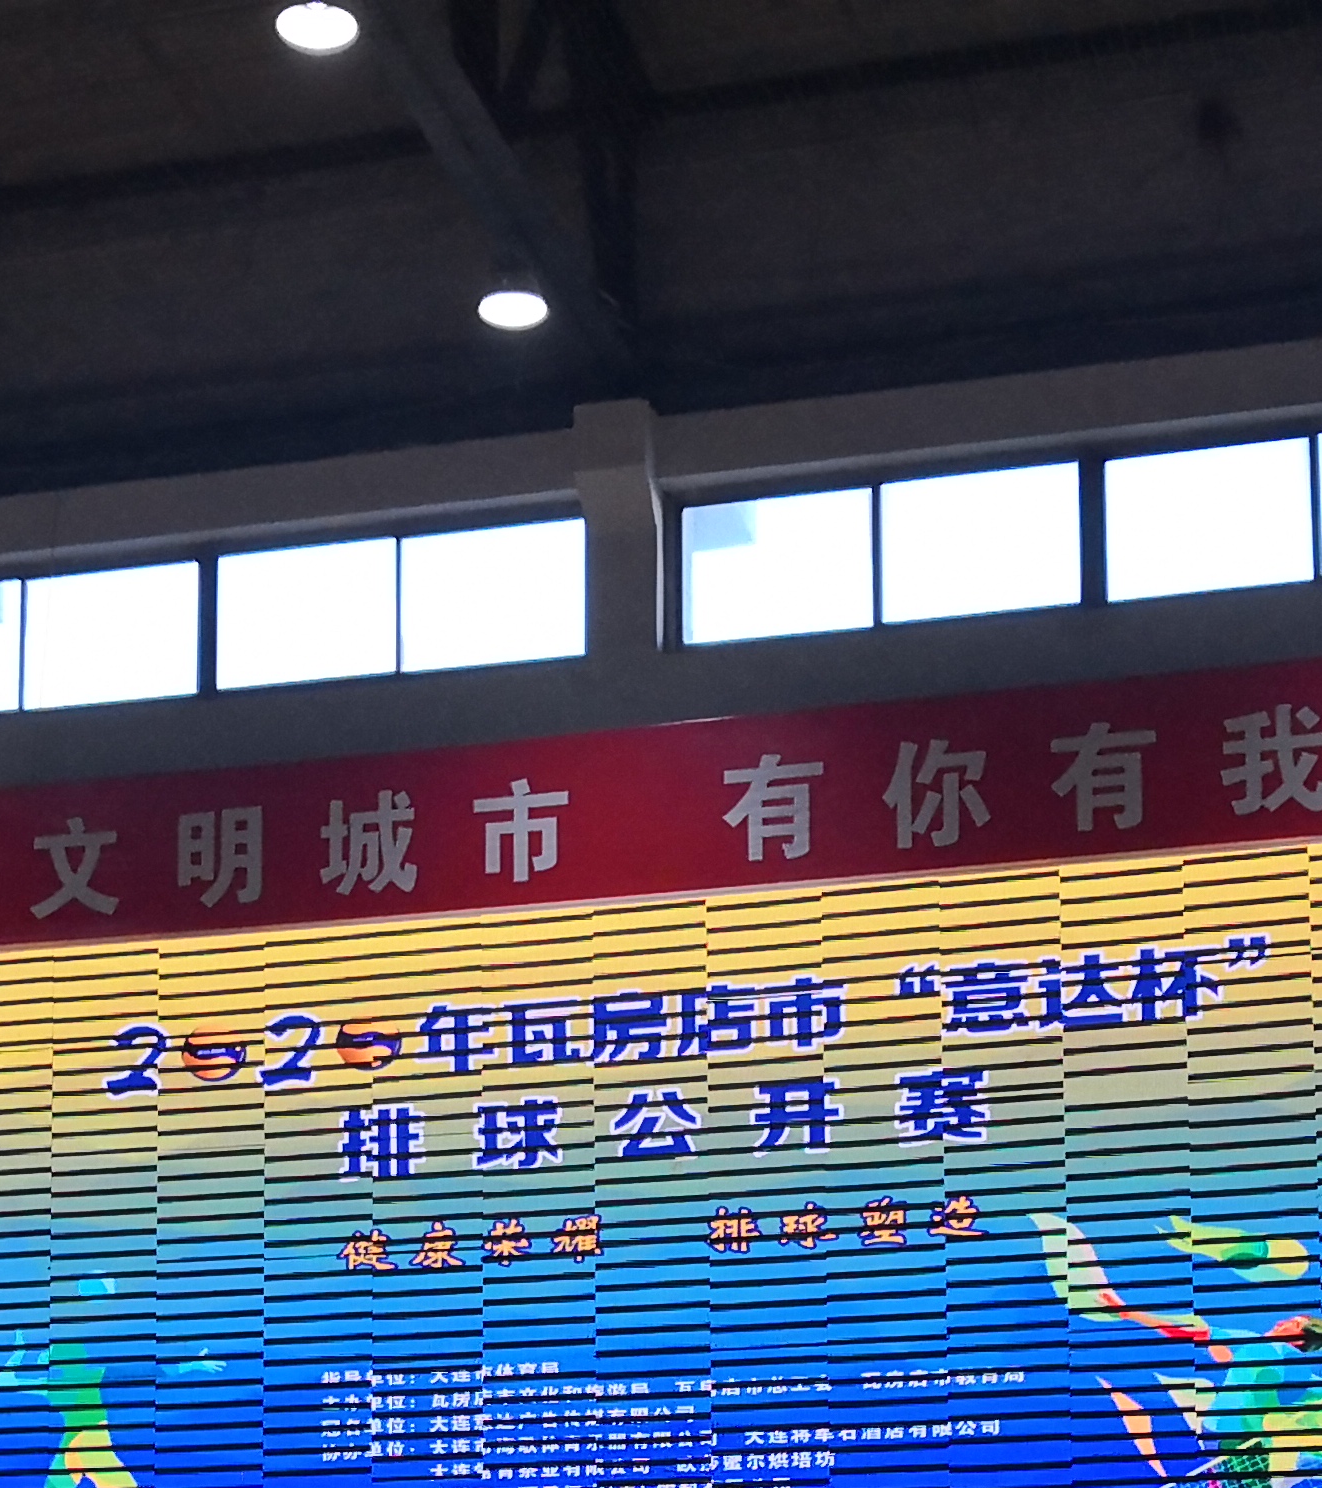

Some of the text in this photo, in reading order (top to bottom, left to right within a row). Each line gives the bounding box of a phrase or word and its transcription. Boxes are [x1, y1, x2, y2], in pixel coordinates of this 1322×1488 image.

[30, 778, 570, 920] 文明城市
[338, 1066, 990, 1182] 排球公开赛
[339, 1196, 986, 1271] 健康荣耀 排球塑造
